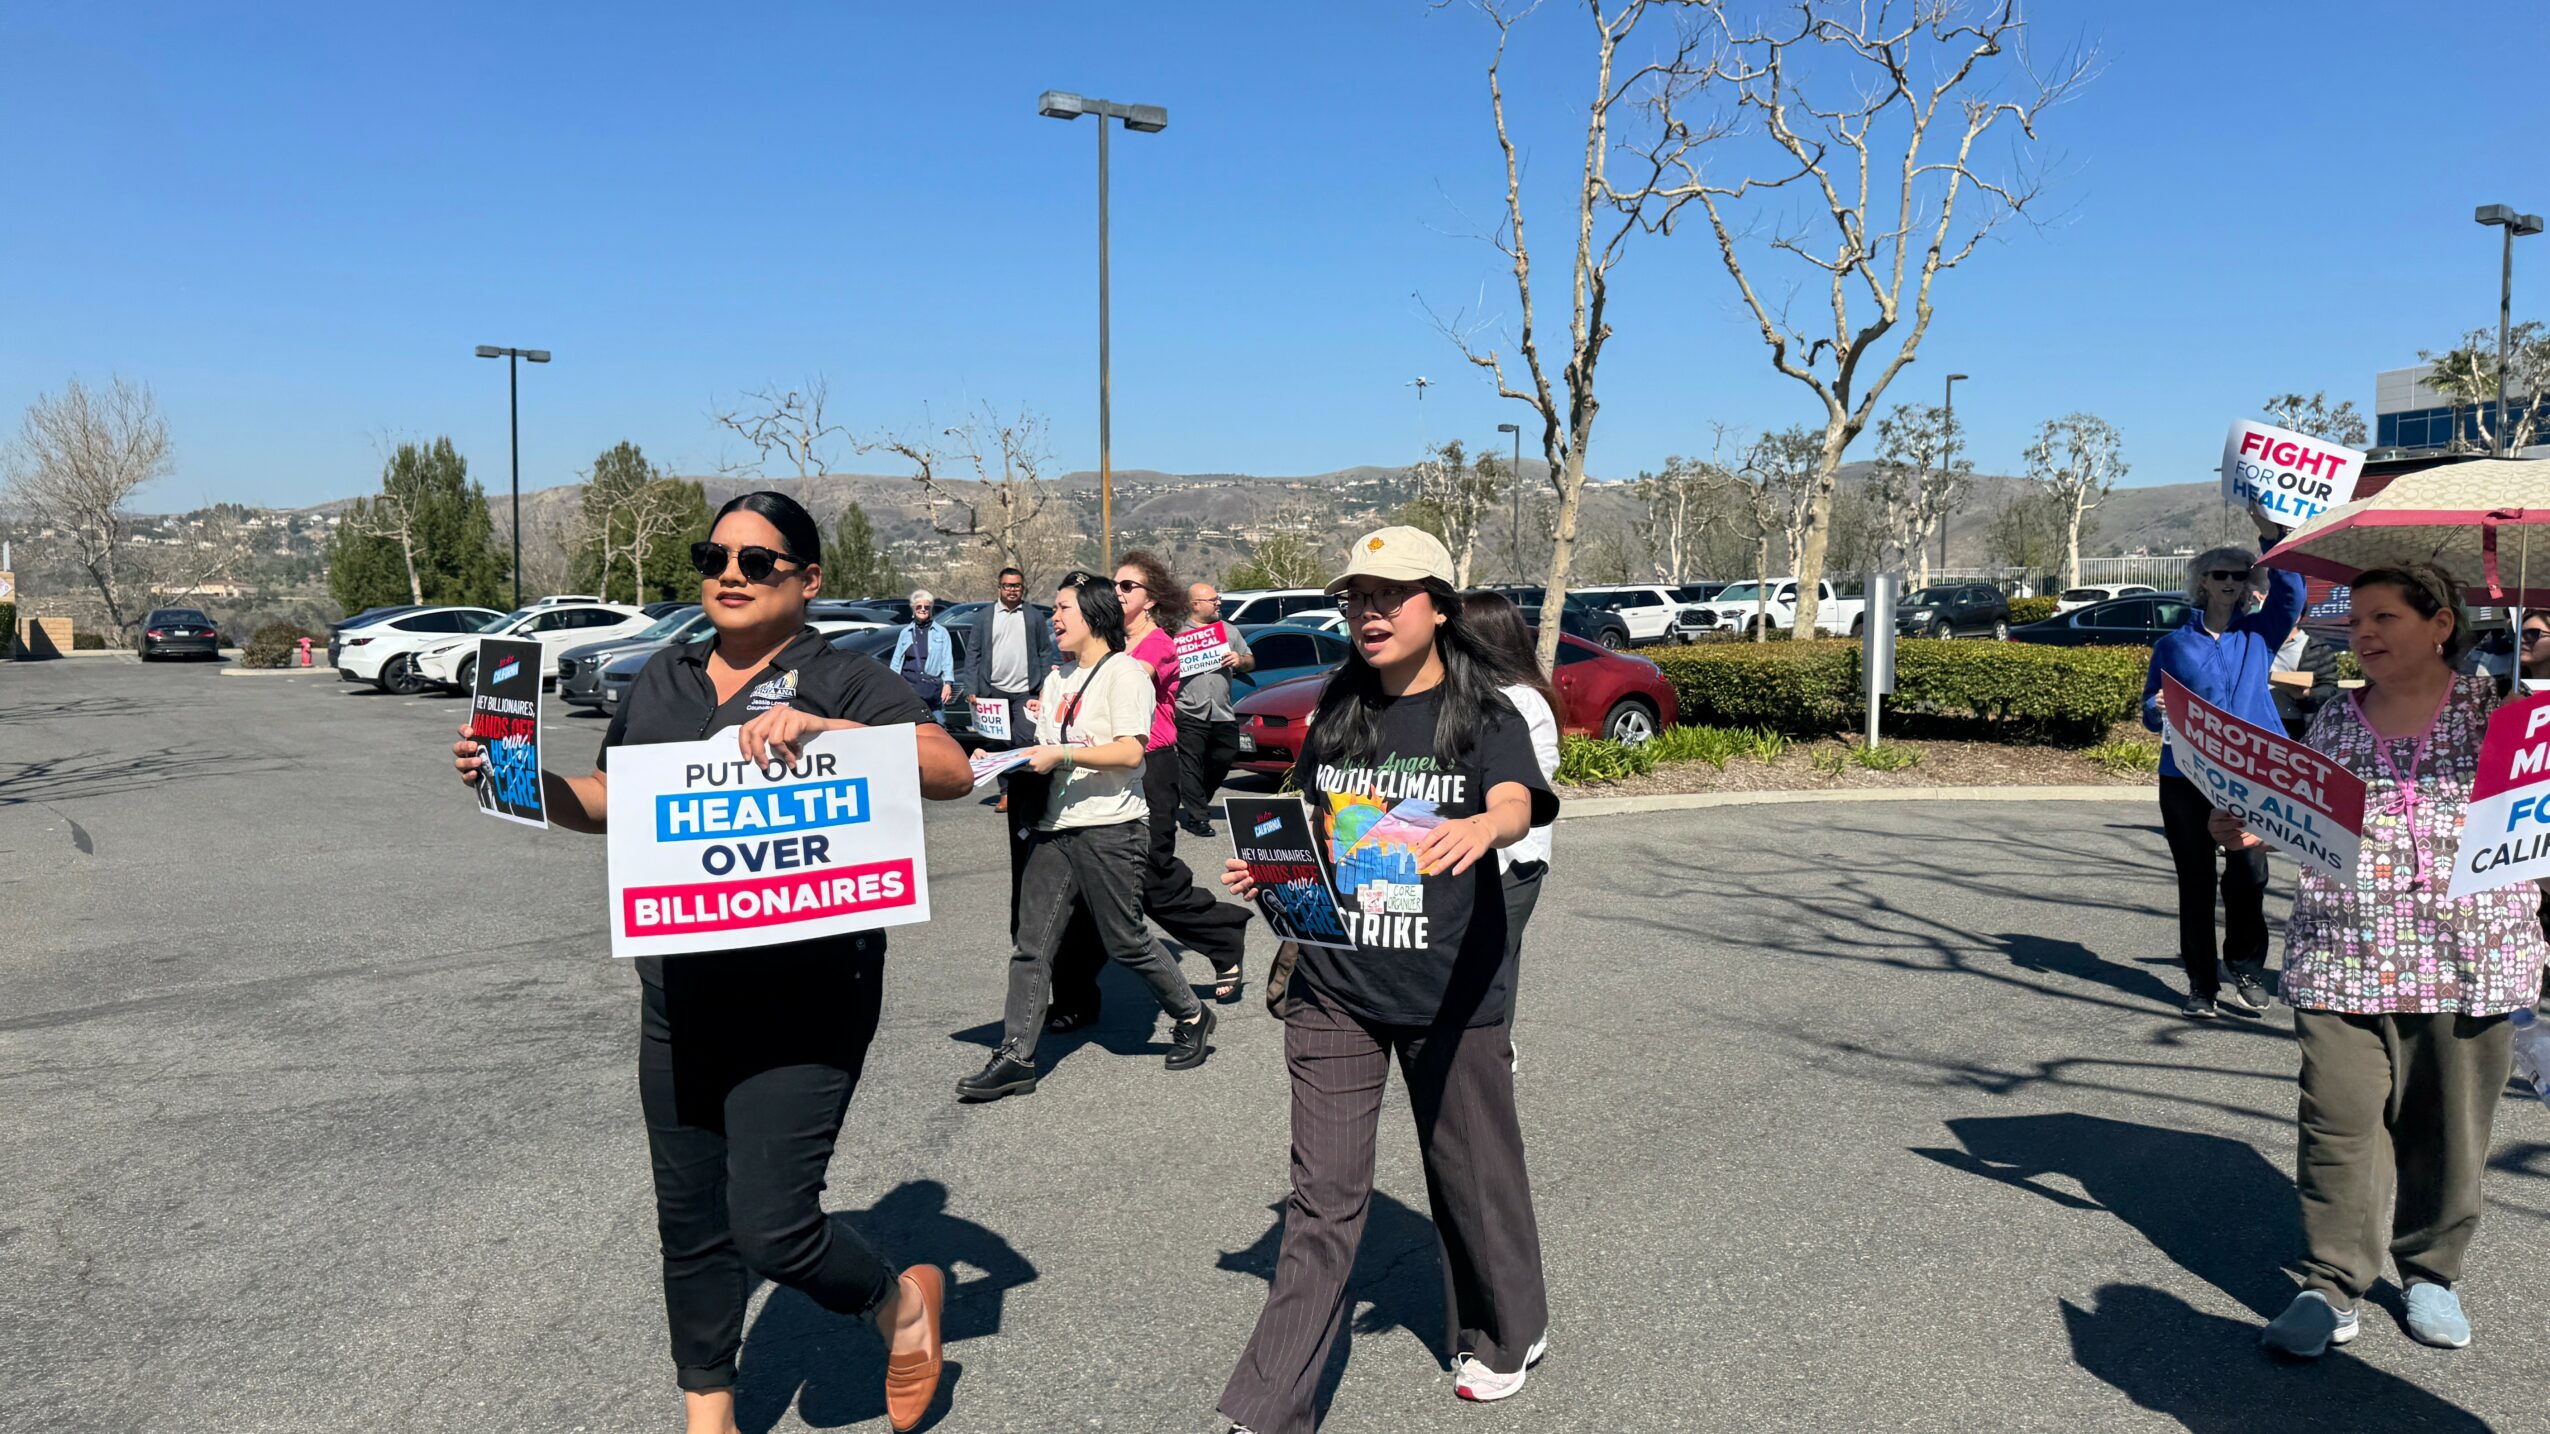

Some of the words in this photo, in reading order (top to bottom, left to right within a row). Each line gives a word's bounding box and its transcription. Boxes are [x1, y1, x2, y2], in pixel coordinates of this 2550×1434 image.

[2240, 431, 2347, 480] FIGHT
[2233, 478, 2328, 520] HEALTH
[2235, 460, 2275, 485] FOR
[2277, 472, 2333, 502] OUR
[1202, 649, 1221, 661] ALL
[473, 713, 509, 739] HANDS
[476, 694, 489, 710] HEY
[488, 696, 536, 718] BILLIONAIRES,
[981, 715, 1002, 725] OUR
[2188, 700, 2332, 784] PROTECT
[686, 760, 752, 788] PUT
[762, 752, 838, 783] OUR
[1315, 763, 1373, 797] YOUTH
[1375, 769, 1467, 804] CLIMATE
[2184, 719, 2333, 813] MEDI-CAL
[494, 765, 540, 809] CARE
[2192, 753, 2249, 804] FOR
[2259, 796, 2322, 839] ALL
[669, 785, 859, 835] HEALTH
[702, 834, 832, 876] OVER
[1241, 847, 1256, 861] HEY
[1257, 848, 1316, 864] BILLIONAIRES,
[634, 870, 905, 927] BILLIONAIRES
[1388, 896, 1422, 912] ORGANIZER
[1393, 885, 1417, 897] CORE
[1286, 903, 1345, 936] CARE
